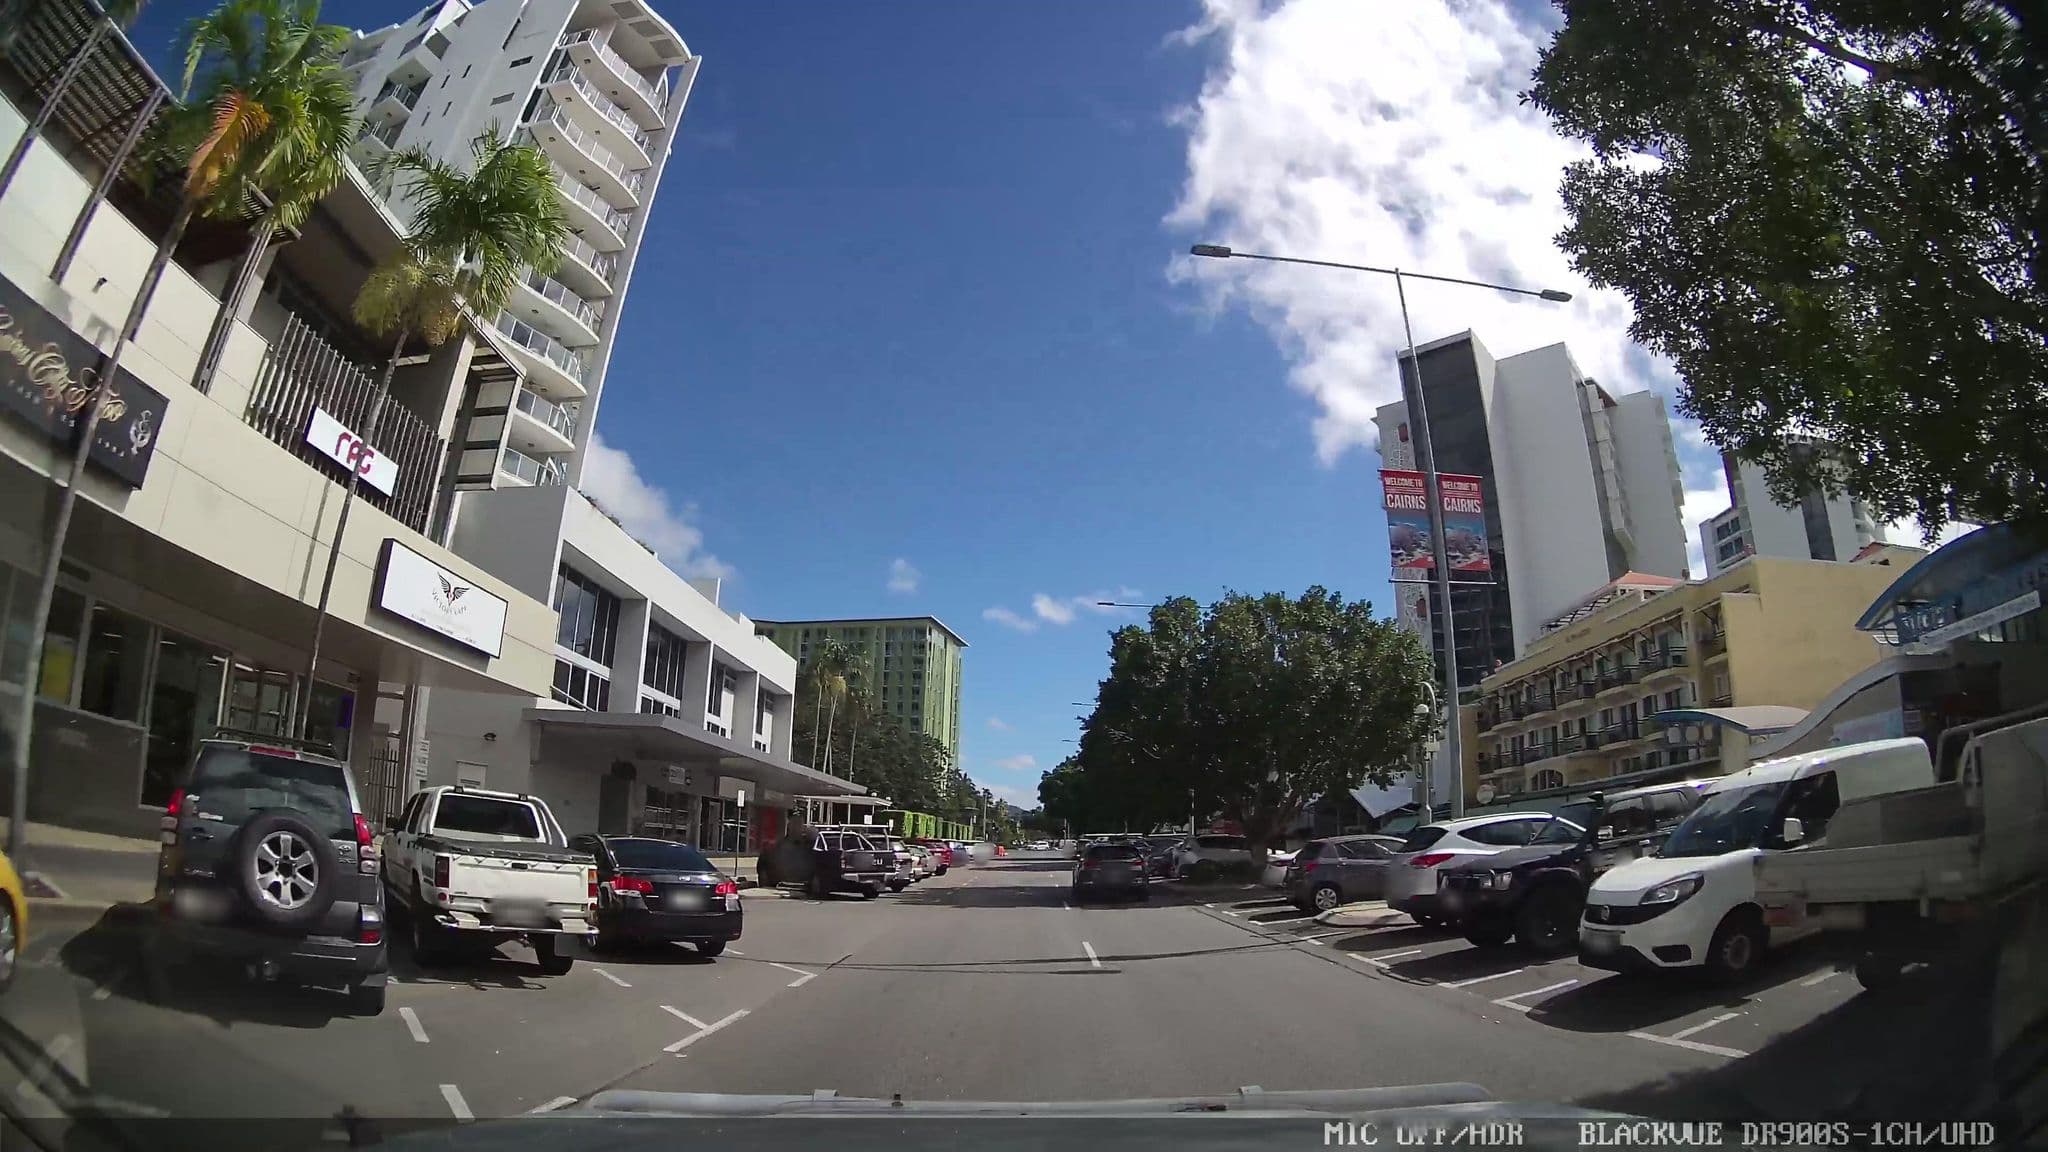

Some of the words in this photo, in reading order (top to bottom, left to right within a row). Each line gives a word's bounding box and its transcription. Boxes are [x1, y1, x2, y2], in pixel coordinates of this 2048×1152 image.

[1384, 477, 1414, 486] WELCOME
[1415, 479, 1423, 487] TO
[1442, 480, 1470, 490] WELCOME
[1470, 482, 1478, 491] TO
[1386, 494, 1426, 509] CAIRNS
[1443, 497, 1481, 513] CAIRNS
